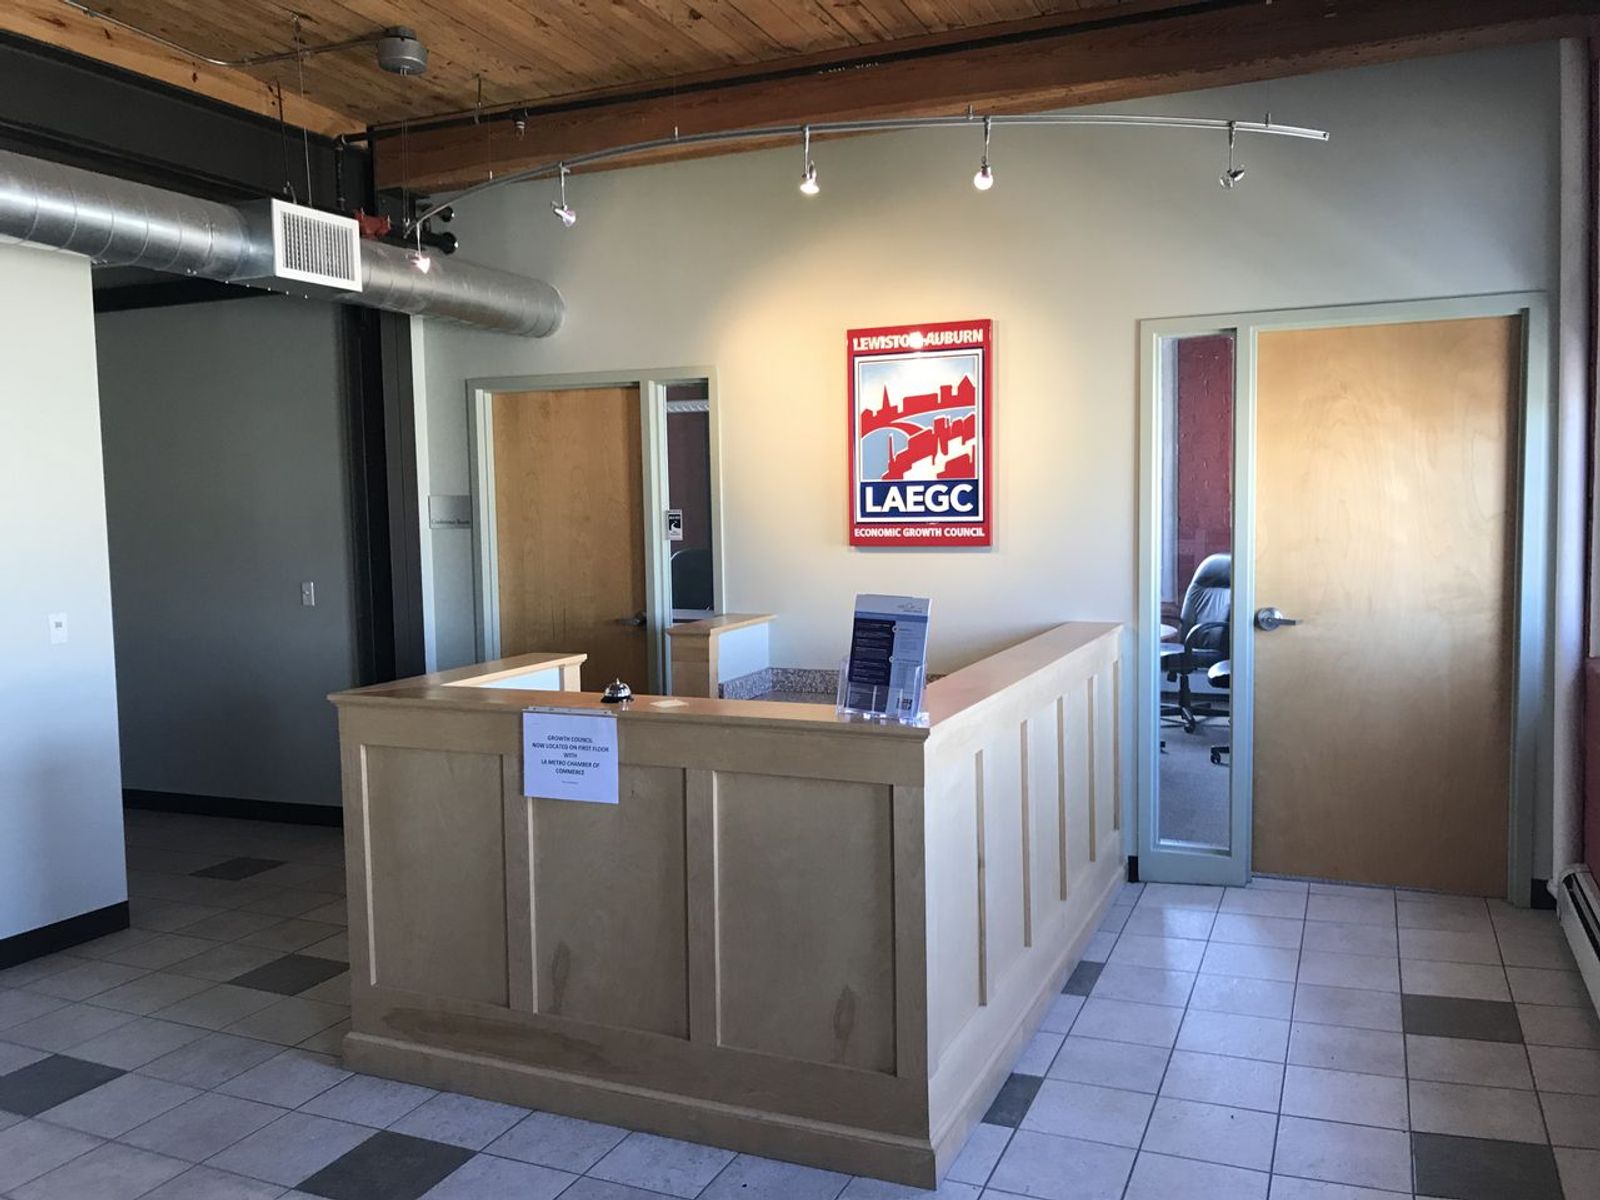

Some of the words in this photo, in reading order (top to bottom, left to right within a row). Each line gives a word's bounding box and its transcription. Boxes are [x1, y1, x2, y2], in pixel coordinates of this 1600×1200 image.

[853, 329, 984, 351] LEWISTO-AUBURN
[865, 484, 973, 513] LAEGC
[854, 528, 901, 538] ECONOMIC
[903, 528, 942, 538] GROWTH
[944, 527, 985, 537] COUNCIL
